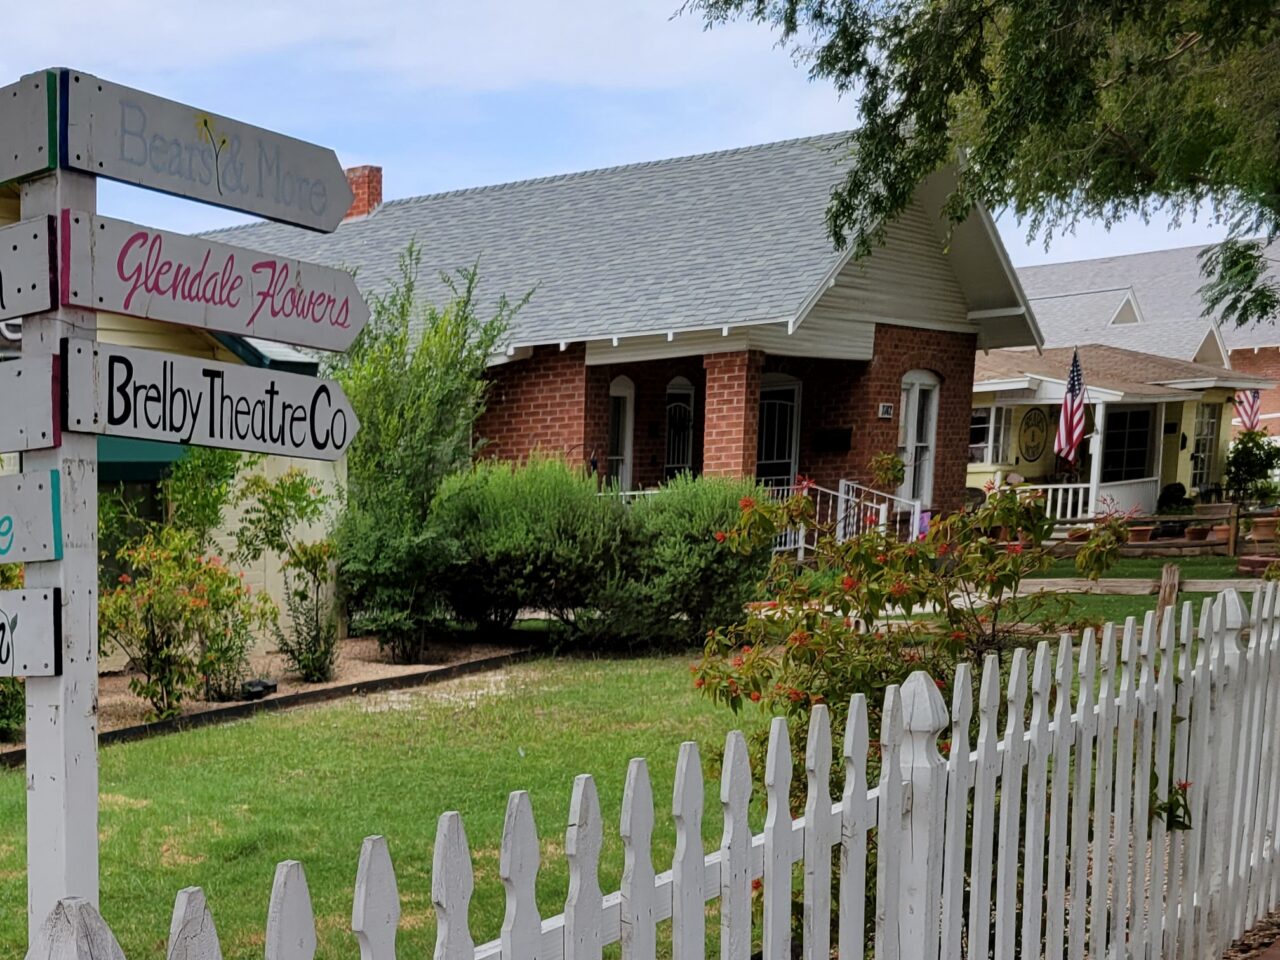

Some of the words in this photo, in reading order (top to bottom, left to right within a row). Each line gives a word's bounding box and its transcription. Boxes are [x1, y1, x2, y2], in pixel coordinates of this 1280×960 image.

[119, 102, 213, 187] Bears
[222, 133, 250, 195] &
[256, 139, 328, 217] More
[116, 231, 244, 310] Glendale
[246, 260, 351, 329] Flowers
[107, 355, 202, 443] Brelby
[202, 368, 307, 448] Theatre
[309, 384, 347, 450] Co
